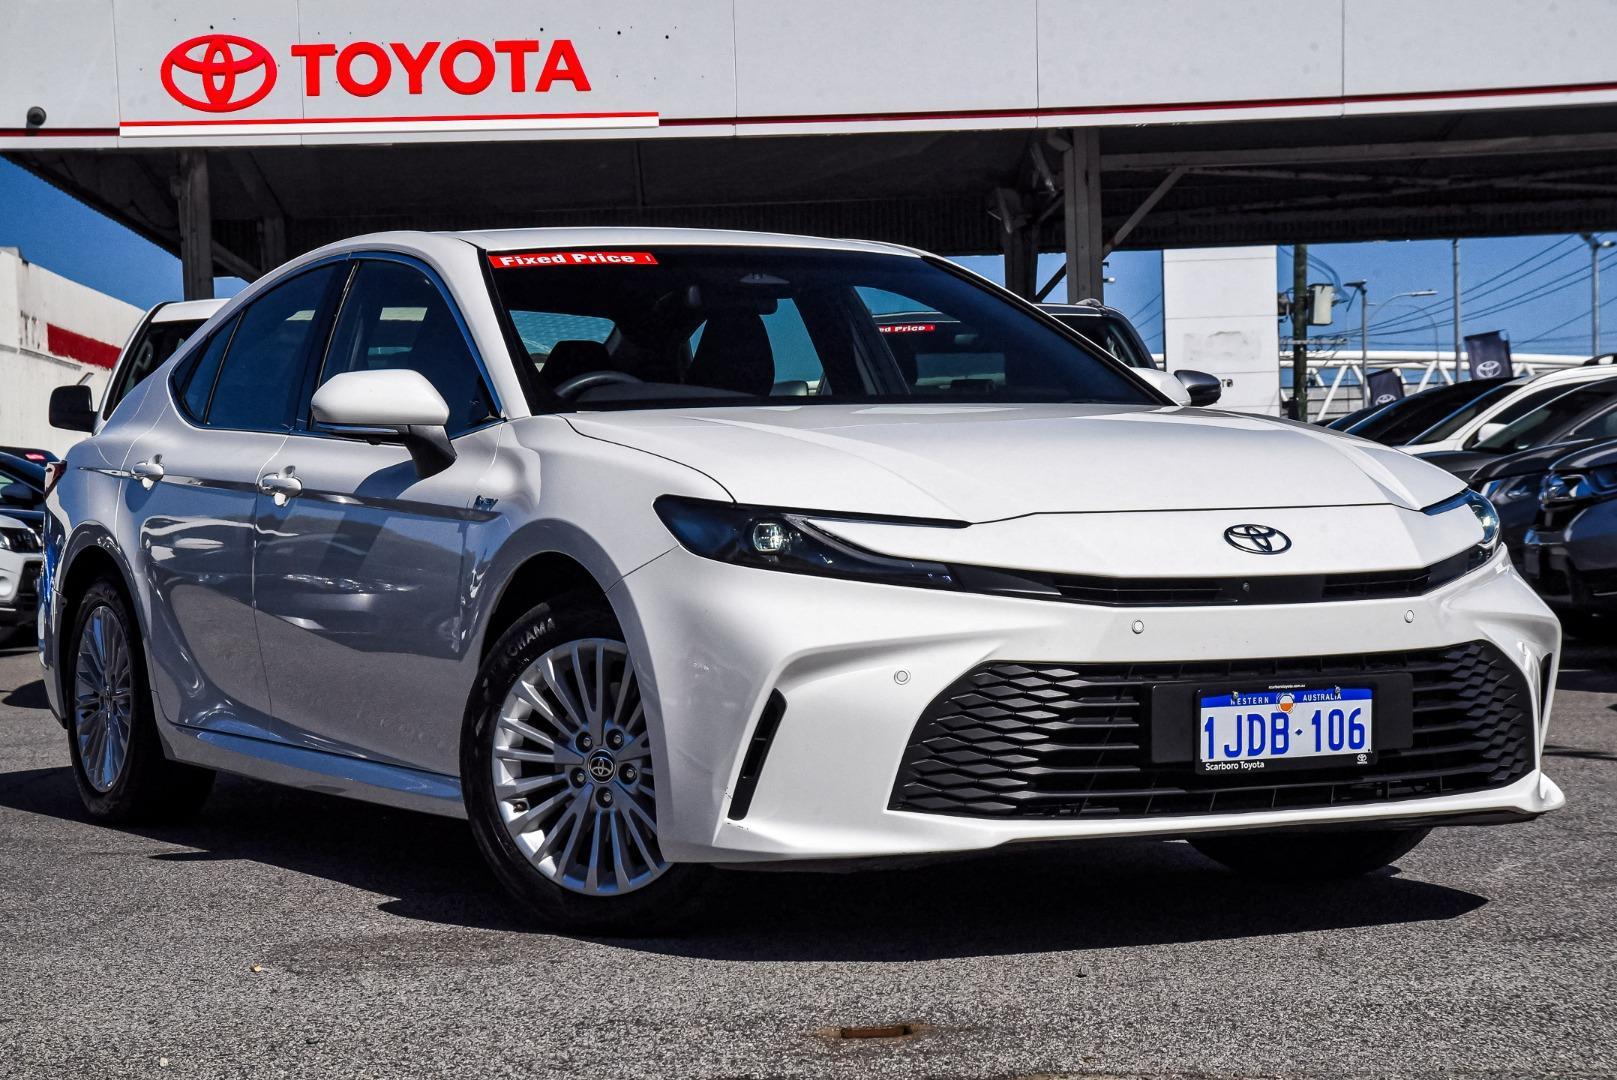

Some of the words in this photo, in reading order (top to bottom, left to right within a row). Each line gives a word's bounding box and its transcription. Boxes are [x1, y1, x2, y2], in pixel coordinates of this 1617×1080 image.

[291, 39, 592, 97] TOYOTA
[500, 254, 567, 266] Fixed
[571, 252, 636, 264] Price
[895, 325, 925, 333] Price
[1205, 761, 1239, 771] Scarboro
[1240, 760, 1265, 771] Toyota
